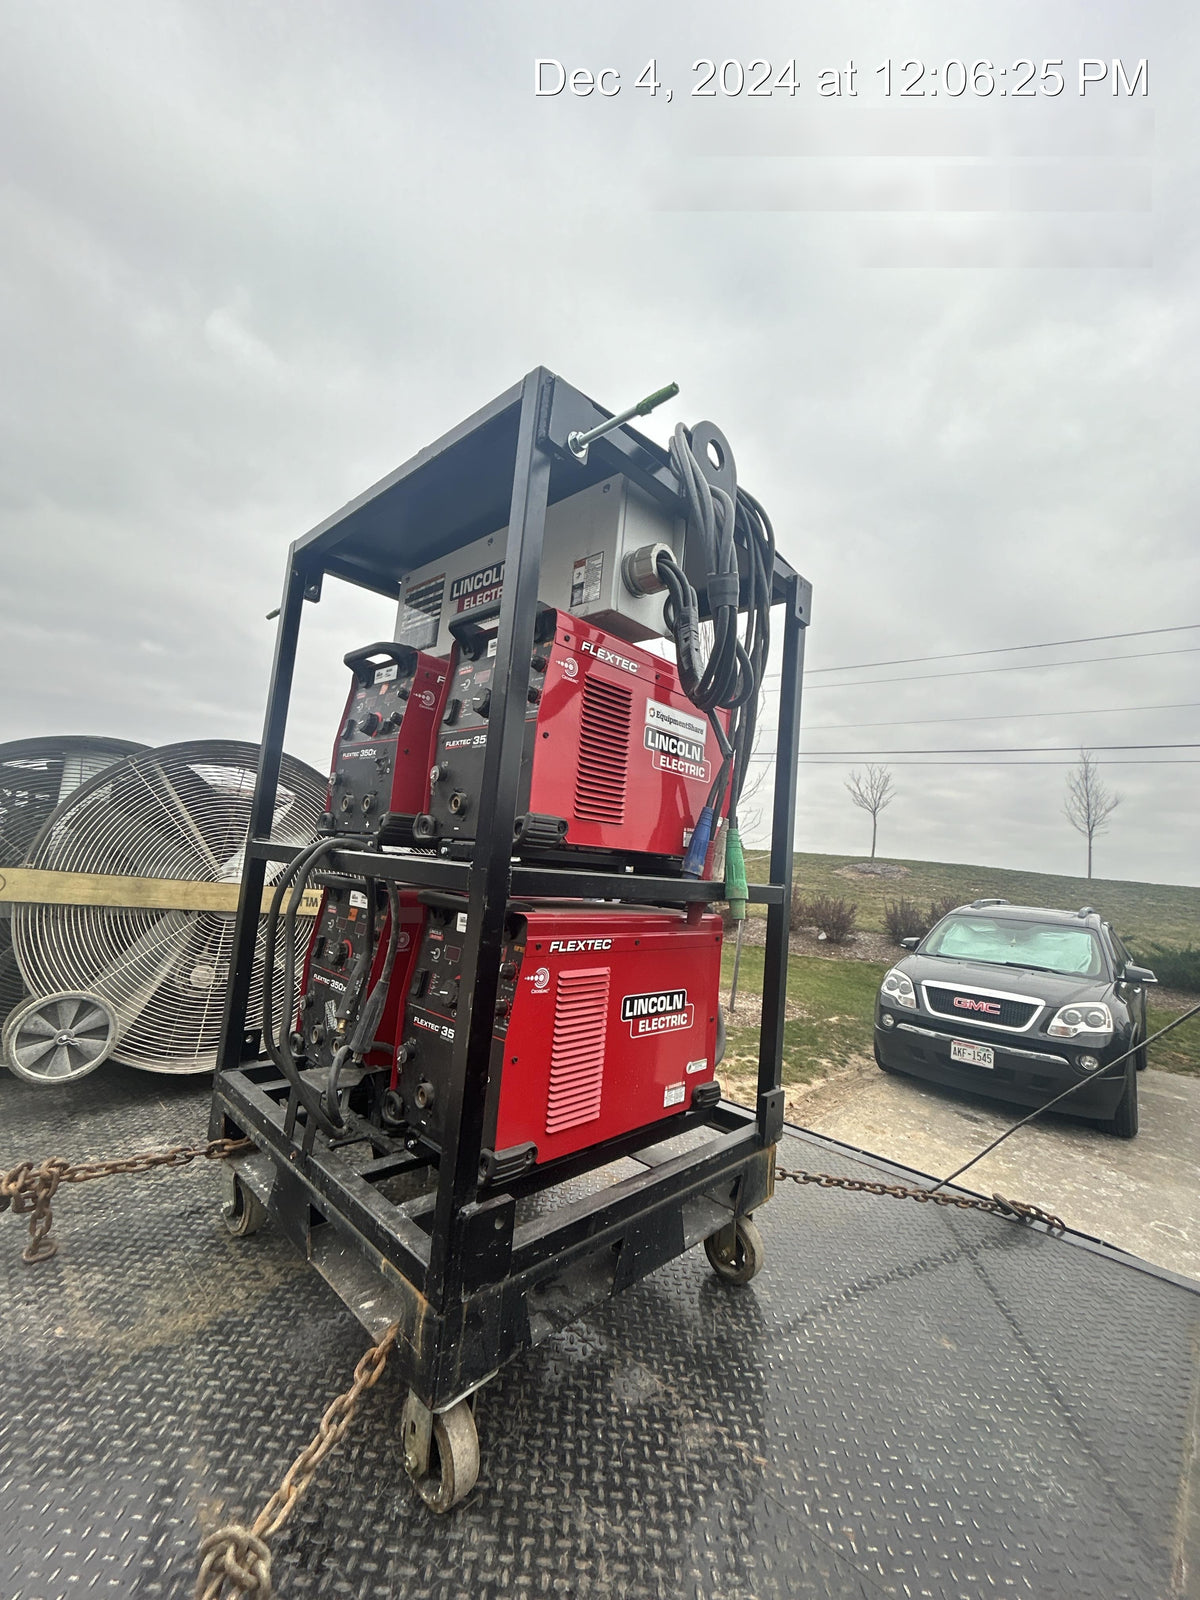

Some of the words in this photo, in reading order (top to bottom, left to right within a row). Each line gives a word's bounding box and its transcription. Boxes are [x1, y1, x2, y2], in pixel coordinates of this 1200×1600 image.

[463, 586, 504, 611] ELECTR
[581, 641, 639, 673] FLEXTEC
[655, 710, 704, 736] EquipmentShare
[445, 738, 471, 748] FLEXTEC
[472, 734, 487, 745] 35
[647, 730, 701, 762] LINCOLN
[659, 755, 706, 778] ELECTRIC
[549, 938, 613, 953] FLEXTEC
[625, 993, 684, 1018] LINCOLN
[953, 996, 1001, 1015] GMC
[413, 1016, 440, 1032] FLEXTEC
[441, 1026, 455, 1039] 35
[638, 1013, 688, 1033] ELECTRIC
[953, 1046, 992, 1064] AKF-1545
